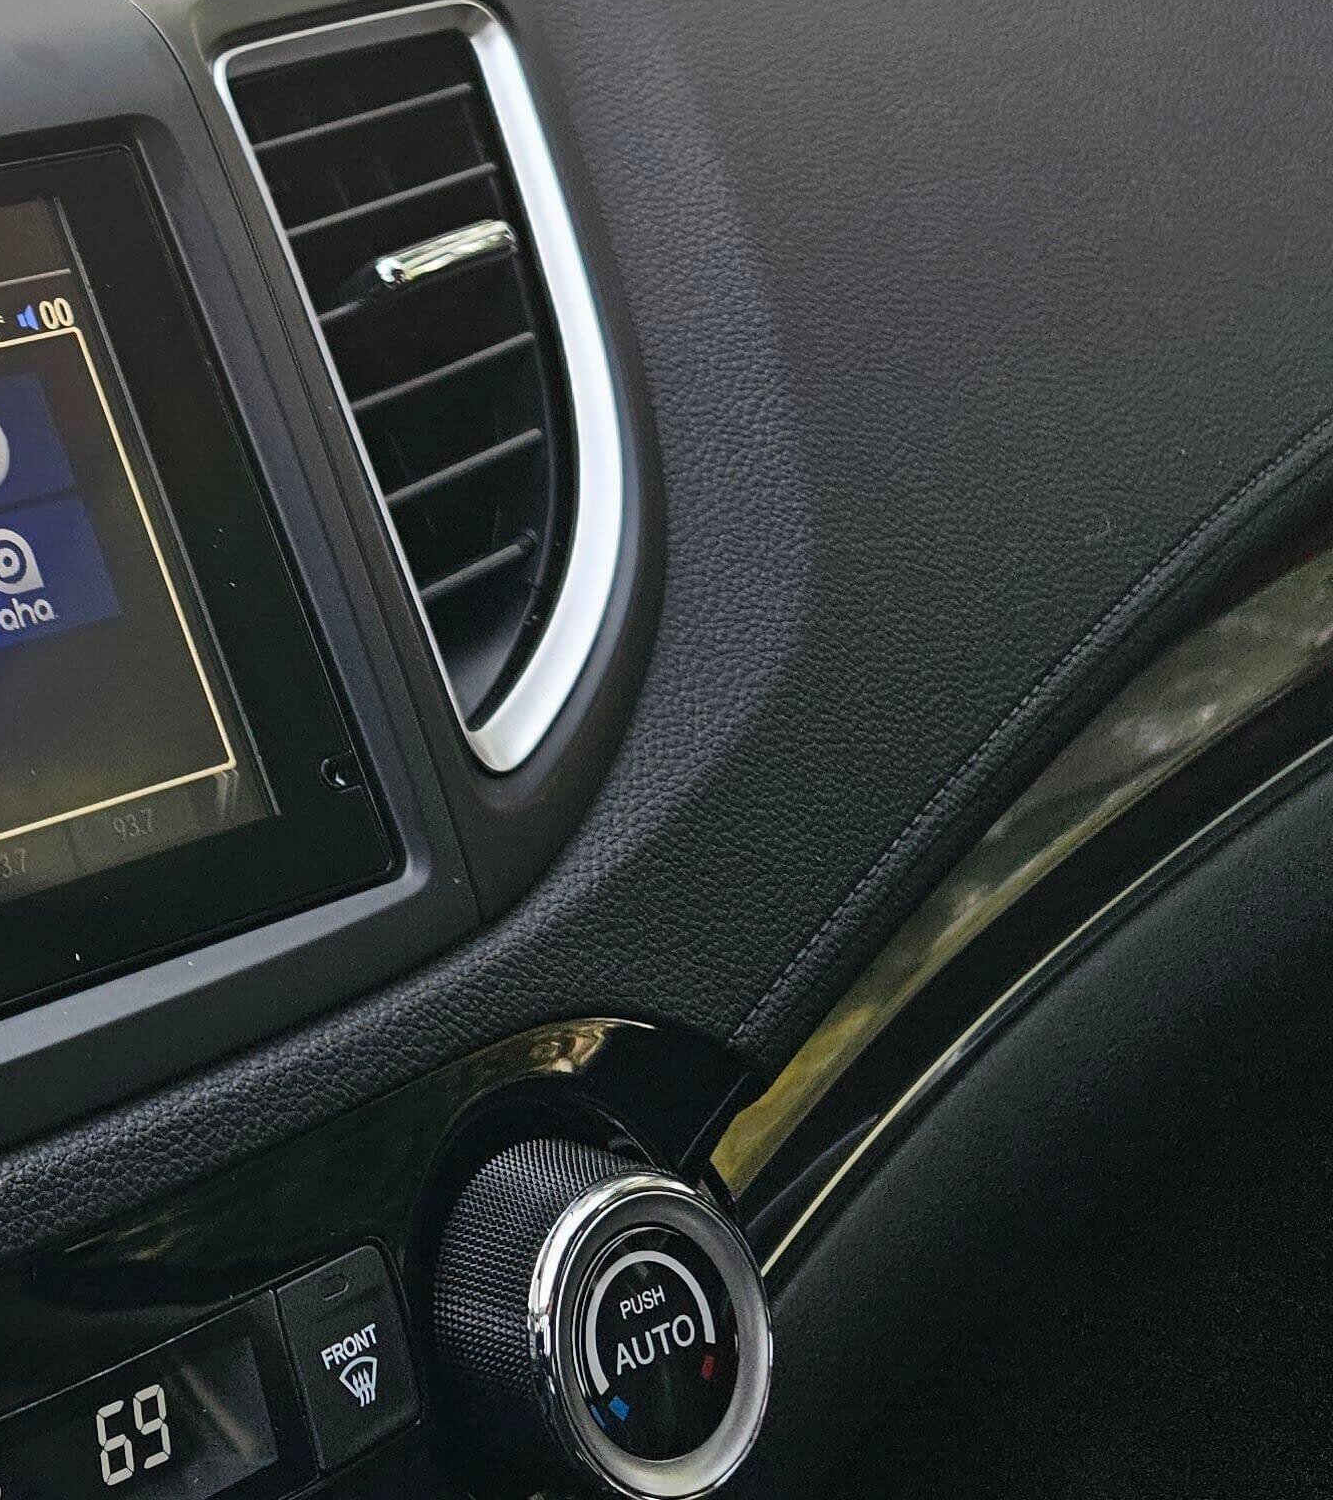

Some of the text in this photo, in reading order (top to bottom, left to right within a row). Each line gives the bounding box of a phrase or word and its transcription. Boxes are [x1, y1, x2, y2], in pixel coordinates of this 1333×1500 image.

[38, 297, 75, 330] 00
[112, 808, 154, 843] 93.7
[619, 1284, 666, 1320] PUSH
[321, 1323, 377, 1371] FRONT
[616, 1314, 695, 1376] AUTO
[95, 1383, 172, 1487] 69
